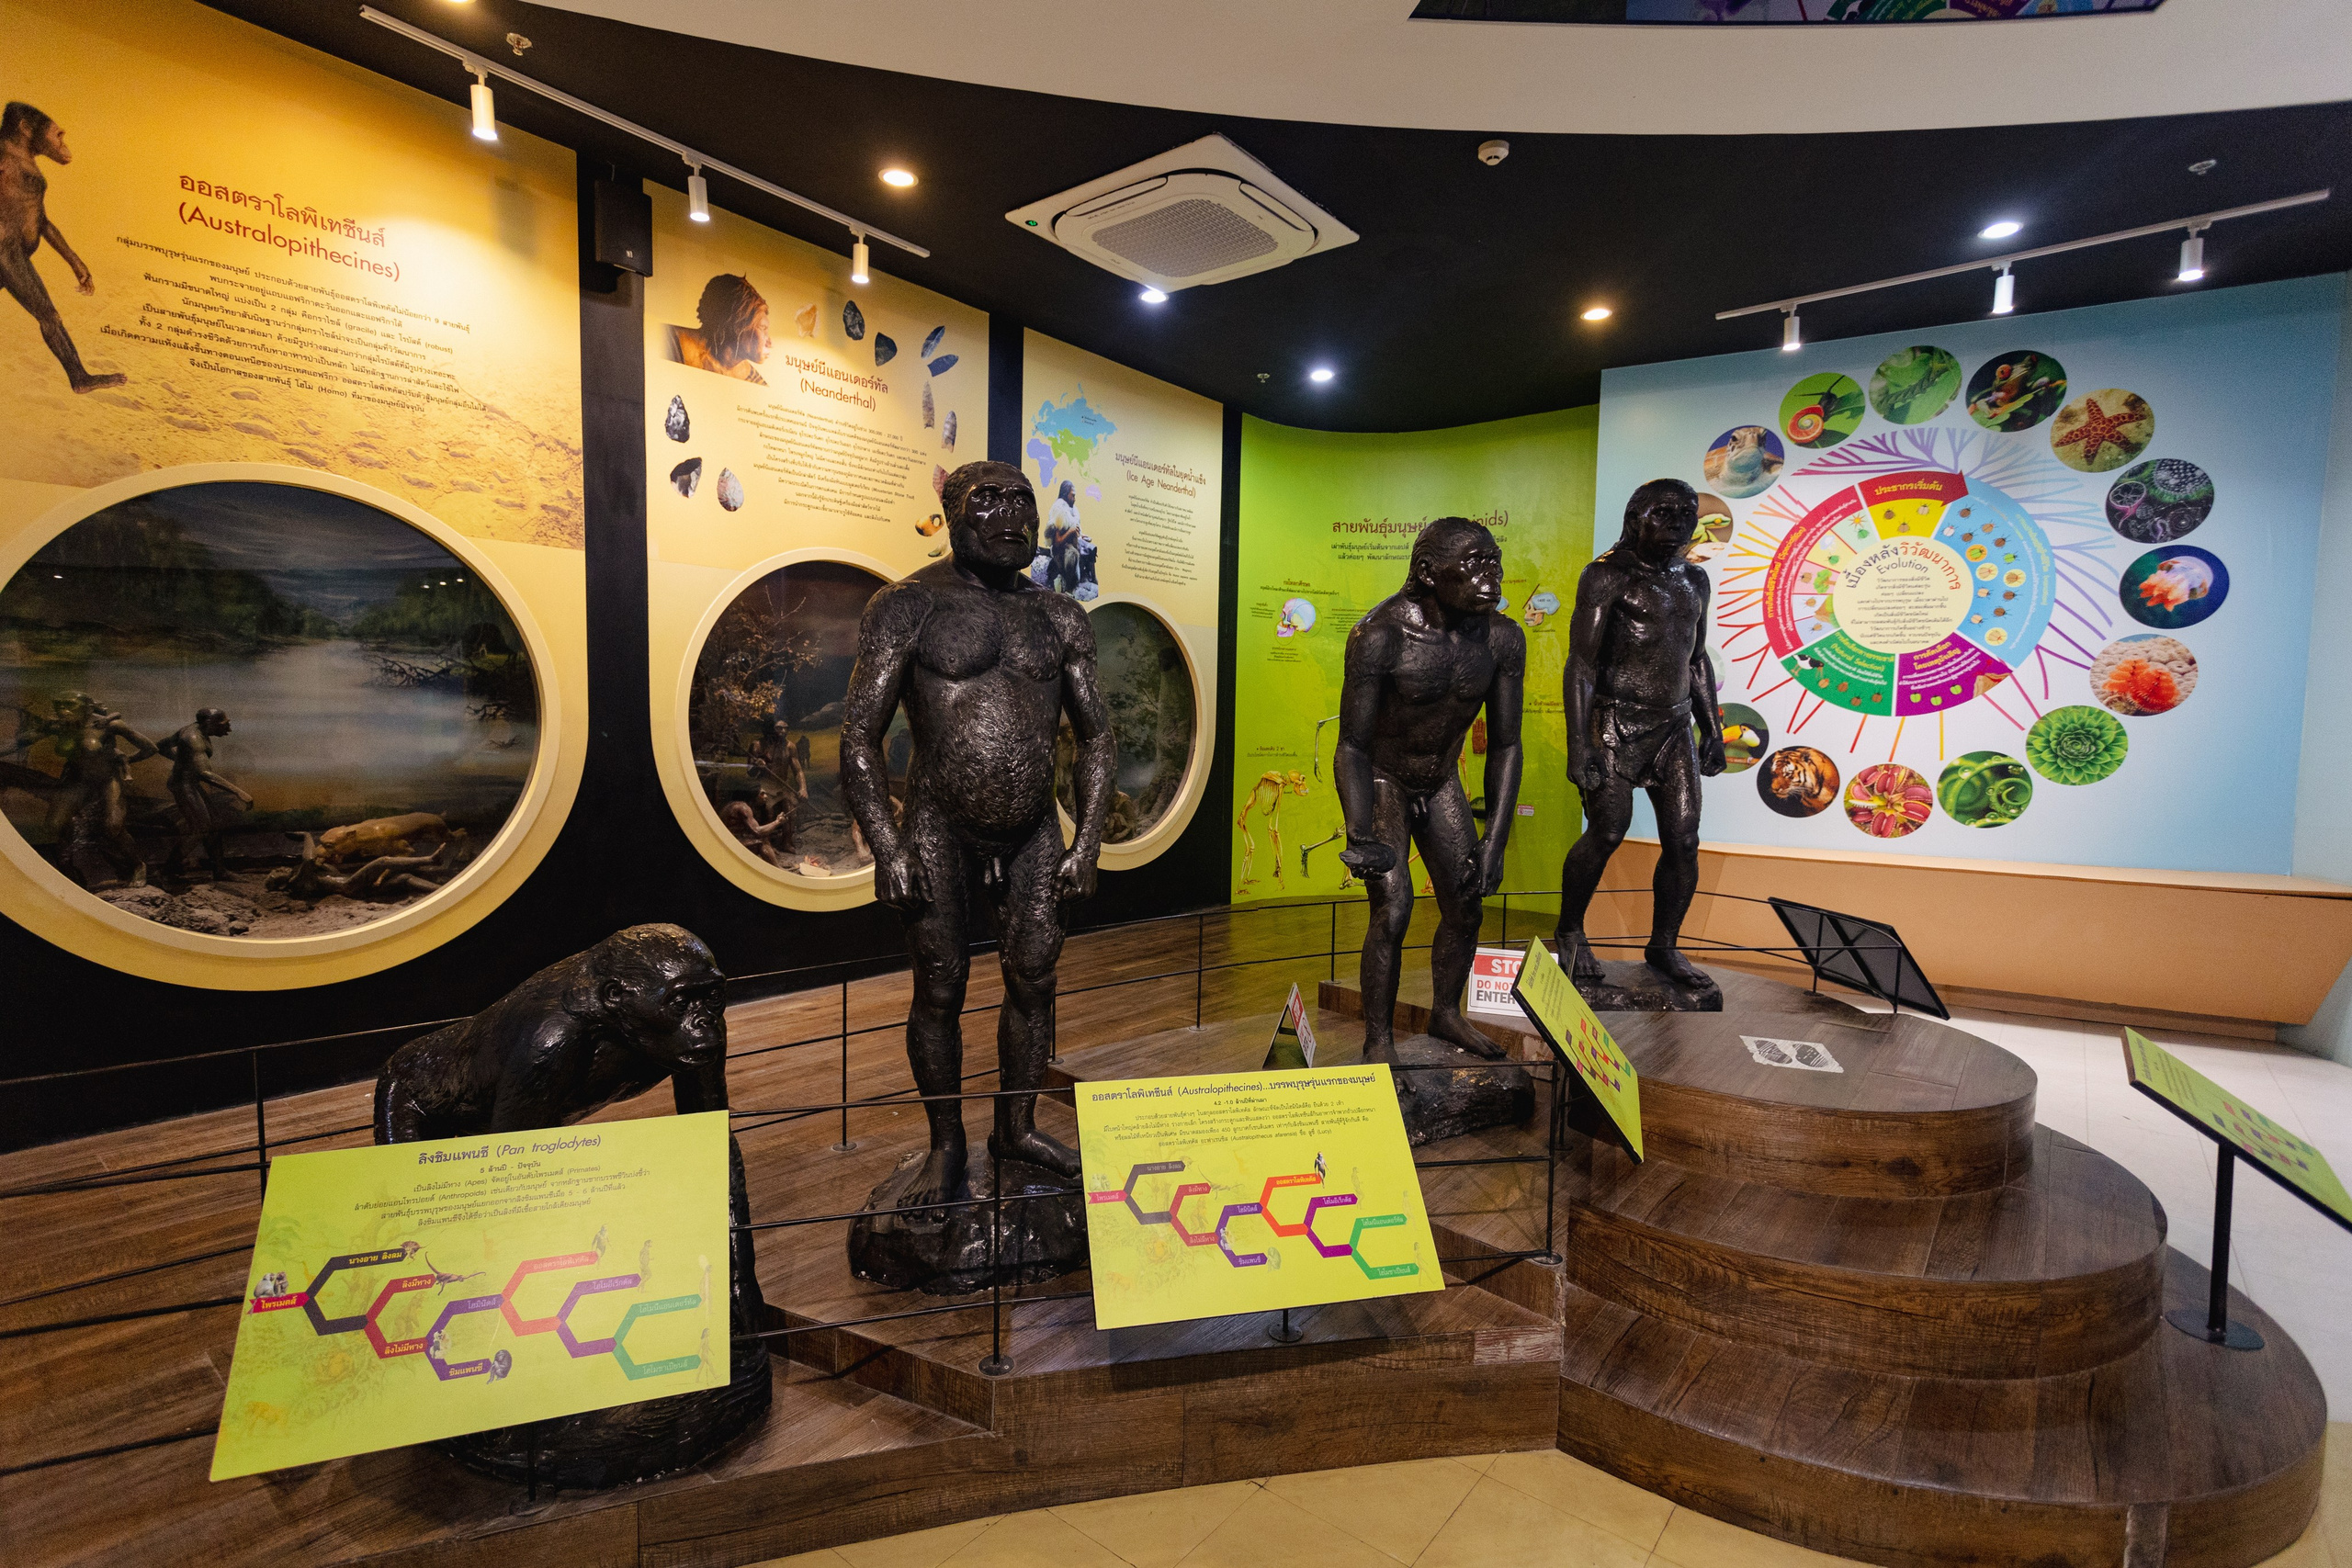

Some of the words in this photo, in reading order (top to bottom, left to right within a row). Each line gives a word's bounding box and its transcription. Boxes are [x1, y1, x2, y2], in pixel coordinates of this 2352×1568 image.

[179, 175, 386, 248] ออสตราโลพิเทซีนส์
[178, 201, 401, 282] (Australopithecines)
[279, 308, 298, 317] กลุ่ม
[345, 322, 377, 335] (gracile)
[424, 342, 454, 355] (robust)
[785, 355, 888, 394] มนุษย์นีแอนเดอร์ทัล
[318, 383, 347, 398] (Homo)
[800, 378, 876, 412] (Neanderthal)
[1126, 469, 1138, 481] (Ice
[1141, 475, 1155, 488] Age
[1157, 478, 1196, 498] Neanderthal)
[1874, 478, 1943, 495] ประชากรเริ่มต้น
[1876, 558, 1928, 575] Evolution
[1491, 958, 1521, 975] STO
[1476, 979, 1492, 989] DO
[1495, 982, 1513, 991] NO
[1476, 990, 1516, 1004] ENTER
[1091, 1086, 1173, 1101] ออสตราโลพิเทซีนส์
[418, 1145, 489, 1165] ลิงชิมแพนซี
[496, 1144, 526, 1158] (Pan
[531, 1134, 602, 1154] troglodytes)
[465, 1179, 487, 1188] (Apes)
[567, 1165, 601, 1175] (Primates)
[438, 1190, 487, 1201] (Anthropoids)
[349, 1255, 378, 1265] นางอาย
[401, 1277, 431, 1288] ลิงมีหาง
[384, 1341, 424, 1355] ลิงไม่มีหาง
[448, 1362, 483, 1376] ชิมแพนซี
